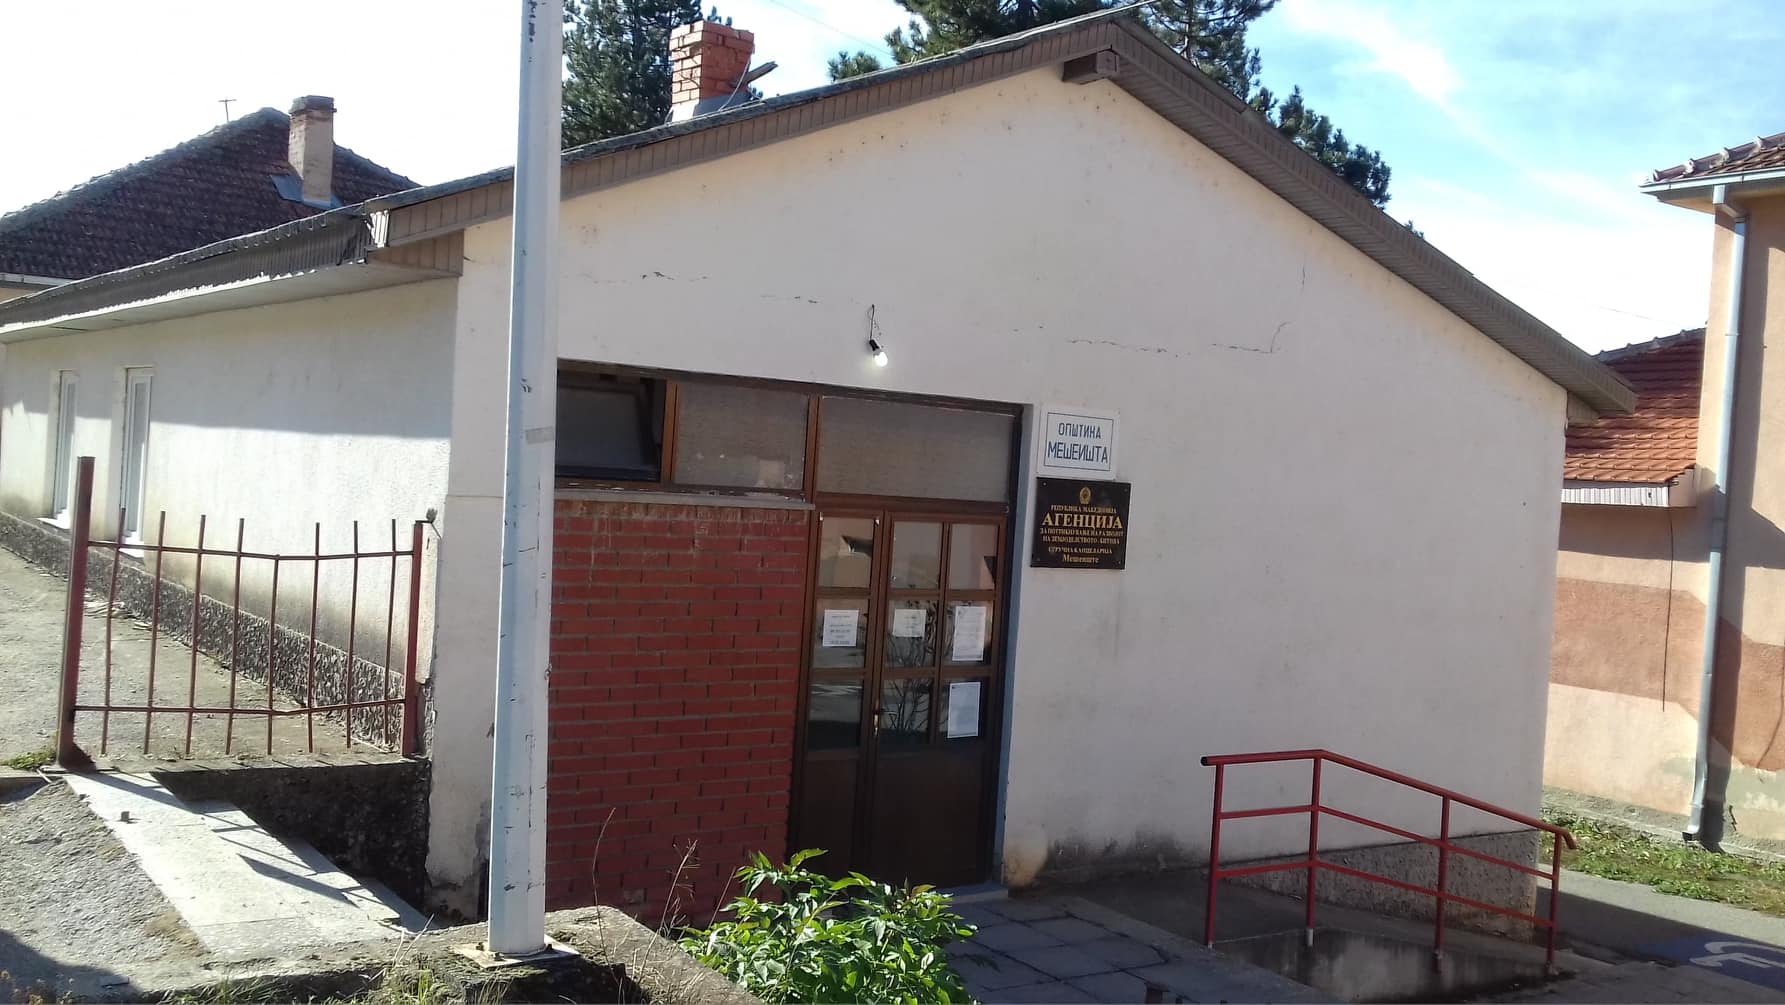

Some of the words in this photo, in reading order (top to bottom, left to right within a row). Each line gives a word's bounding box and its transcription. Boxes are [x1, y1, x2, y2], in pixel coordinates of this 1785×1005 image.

[1058, 422, 1101, 439] ОПШТИНА
[1048, 441, 1108, 463] МЕШЕИШТА
[1041, 512, 1123, 530] АГЕНЦИЈА
